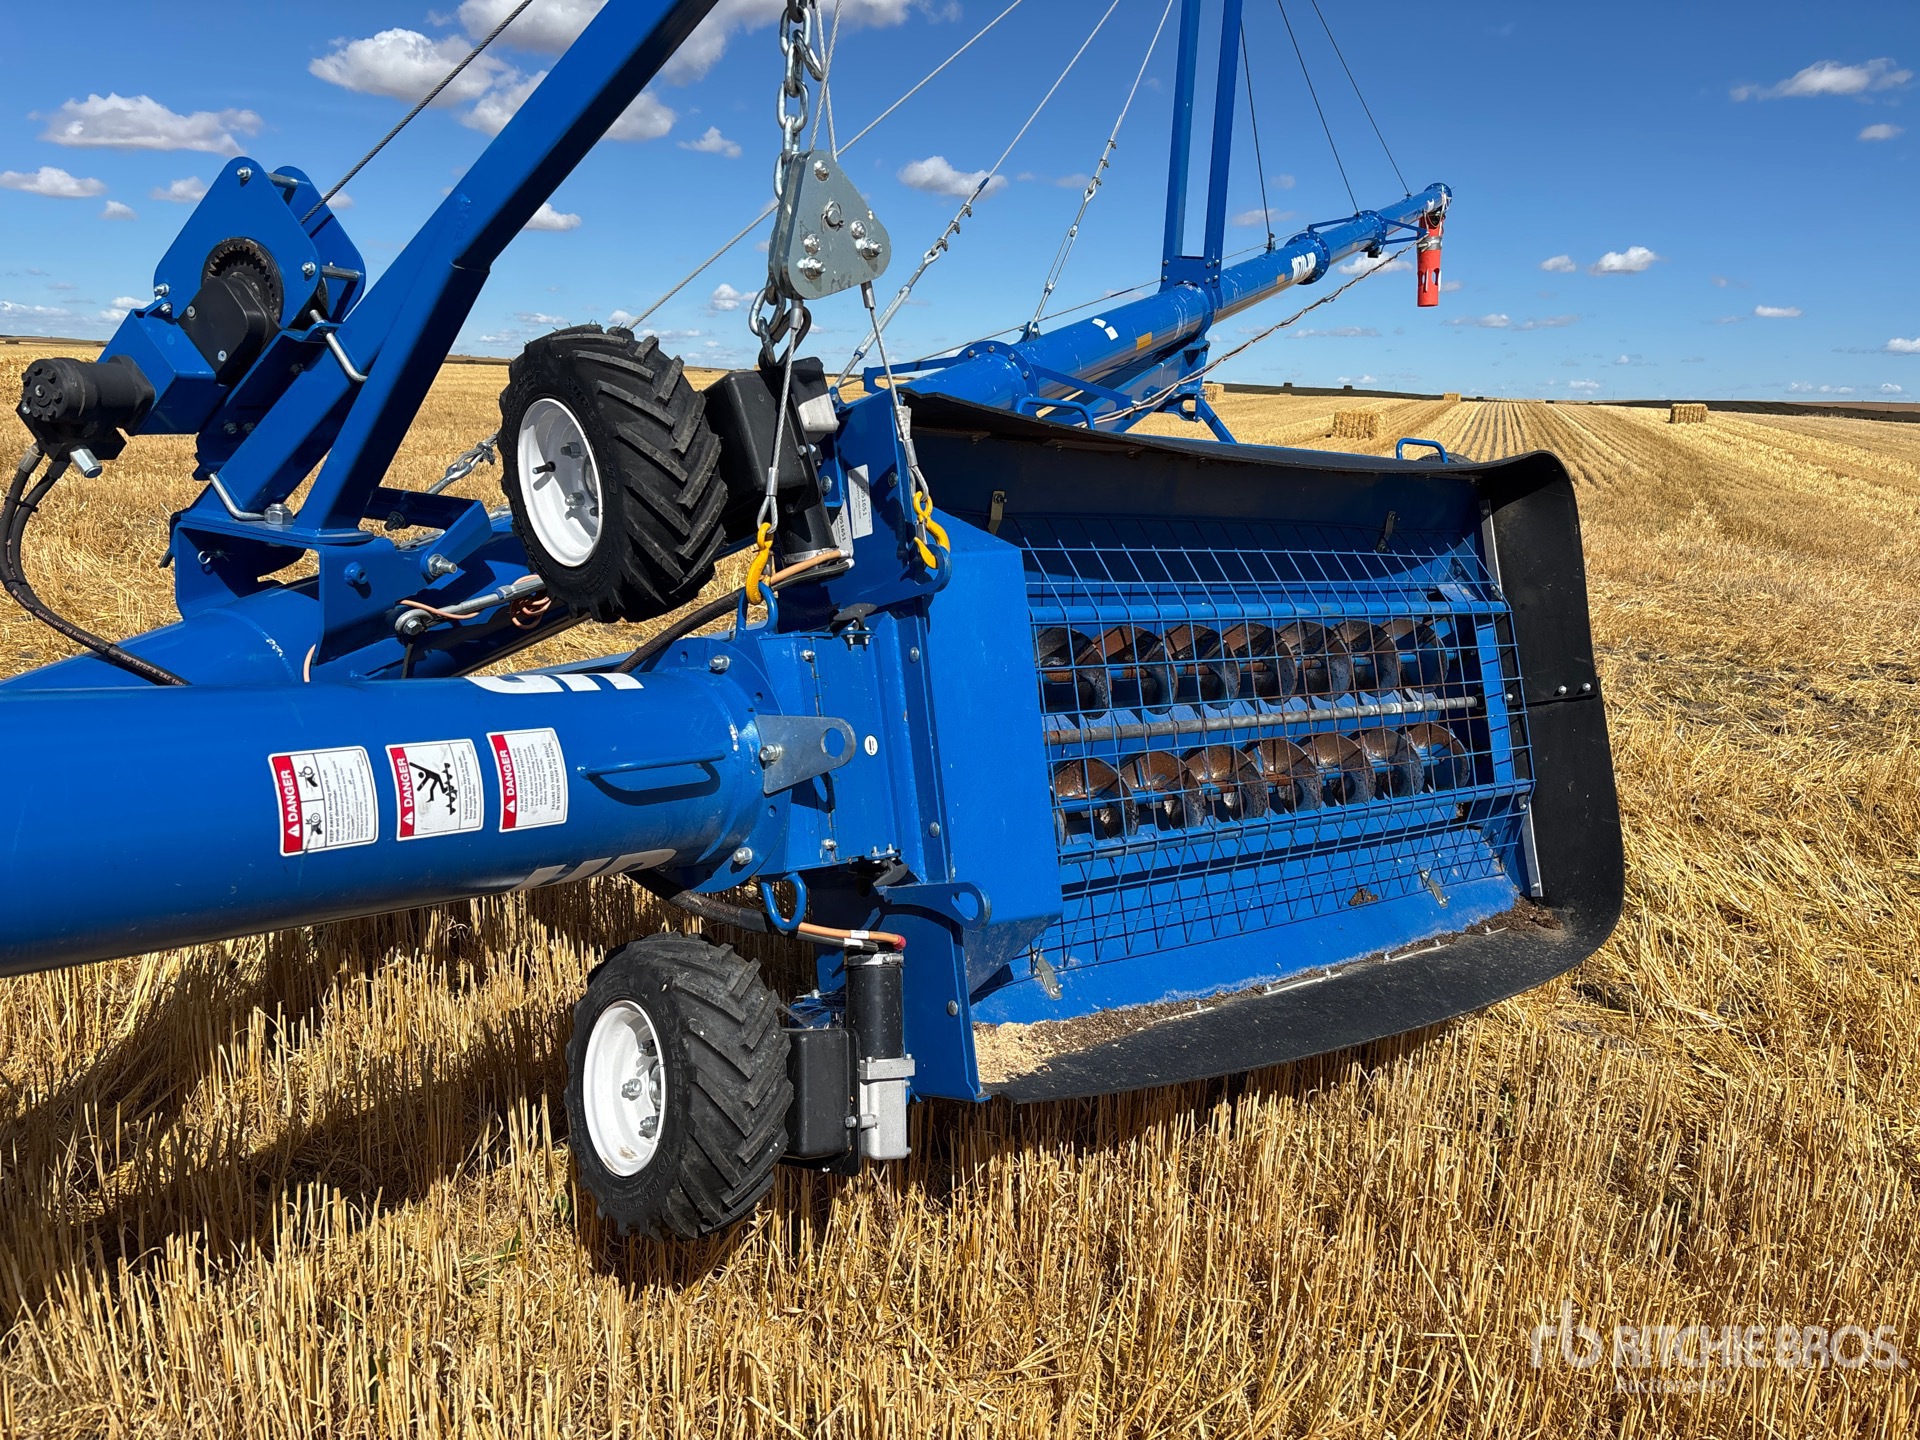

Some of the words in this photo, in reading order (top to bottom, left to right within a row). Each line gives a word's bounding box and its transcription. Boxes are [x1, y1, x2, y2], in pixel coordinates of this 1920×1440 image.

[281, 770, 298, 822] DANGER
[397, 758, 413, 807] DANGER
[500, 750, 514, 796] DANGER
